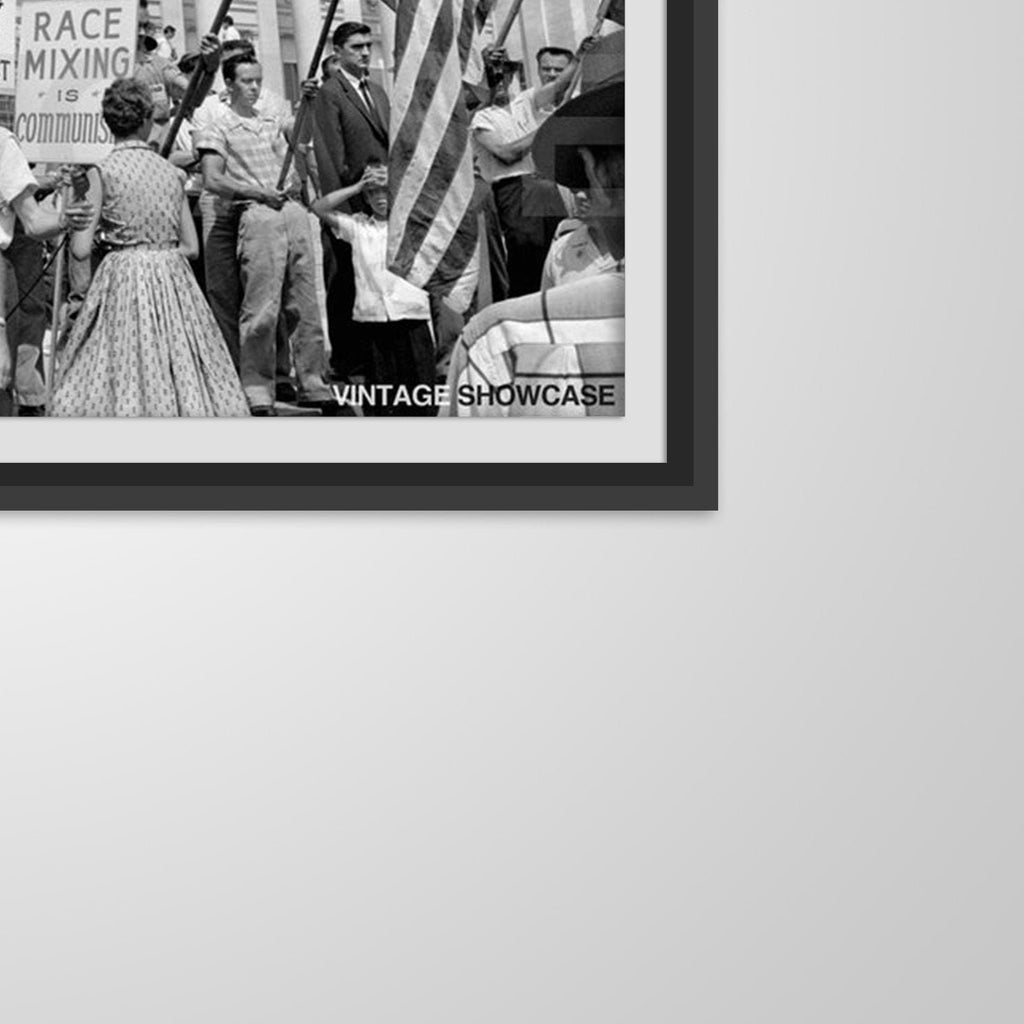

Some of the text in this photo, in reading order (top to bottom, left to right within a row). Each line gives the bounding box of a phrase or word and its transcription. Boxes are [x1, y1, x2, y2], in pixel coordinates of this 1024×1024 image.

[33, 7, 123, 42] RACE
[24, 46, 130, 80] MIXING
[57, 89, 79, 103] IS
